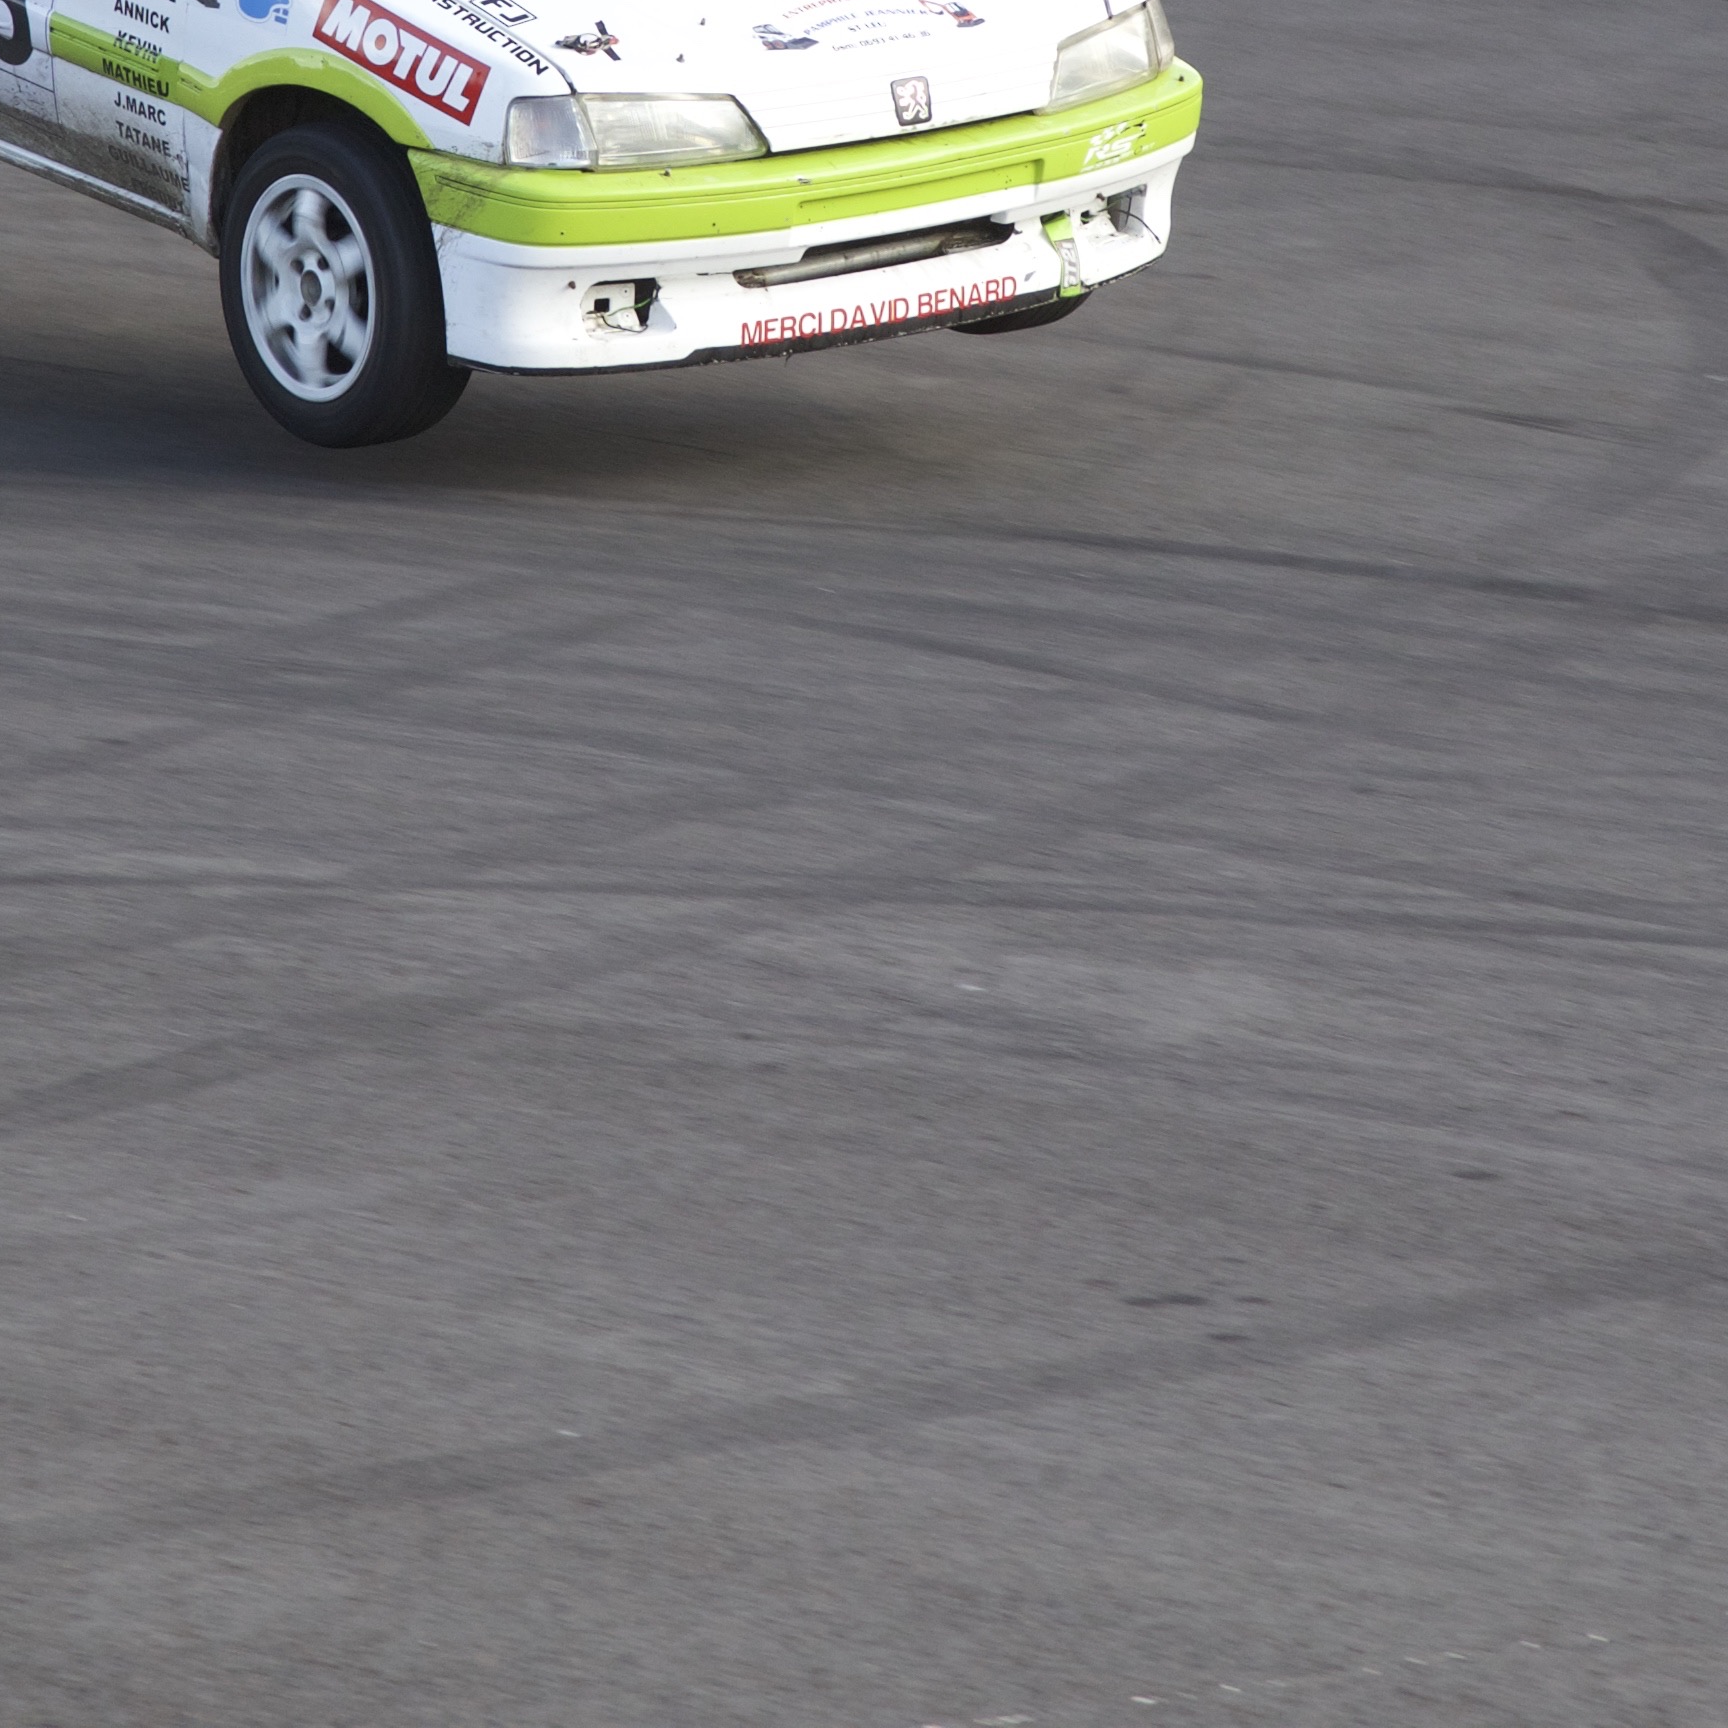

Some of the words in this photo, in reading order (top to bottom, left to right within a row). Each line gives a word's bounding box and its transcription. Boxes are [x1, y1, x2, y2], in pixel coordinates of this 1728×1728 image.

[113, 29, 163, 65] KEVIN
[102, 57, 170, 98] MATHIEU
[114, 91, 167, 127] J.MARC
[115, 120, 174, 158] TATANE
[740, 311, 823, 348] MERCI
[829, 297, 910, 335] DAVID
[917, 276, 1018, 319] BENARD
